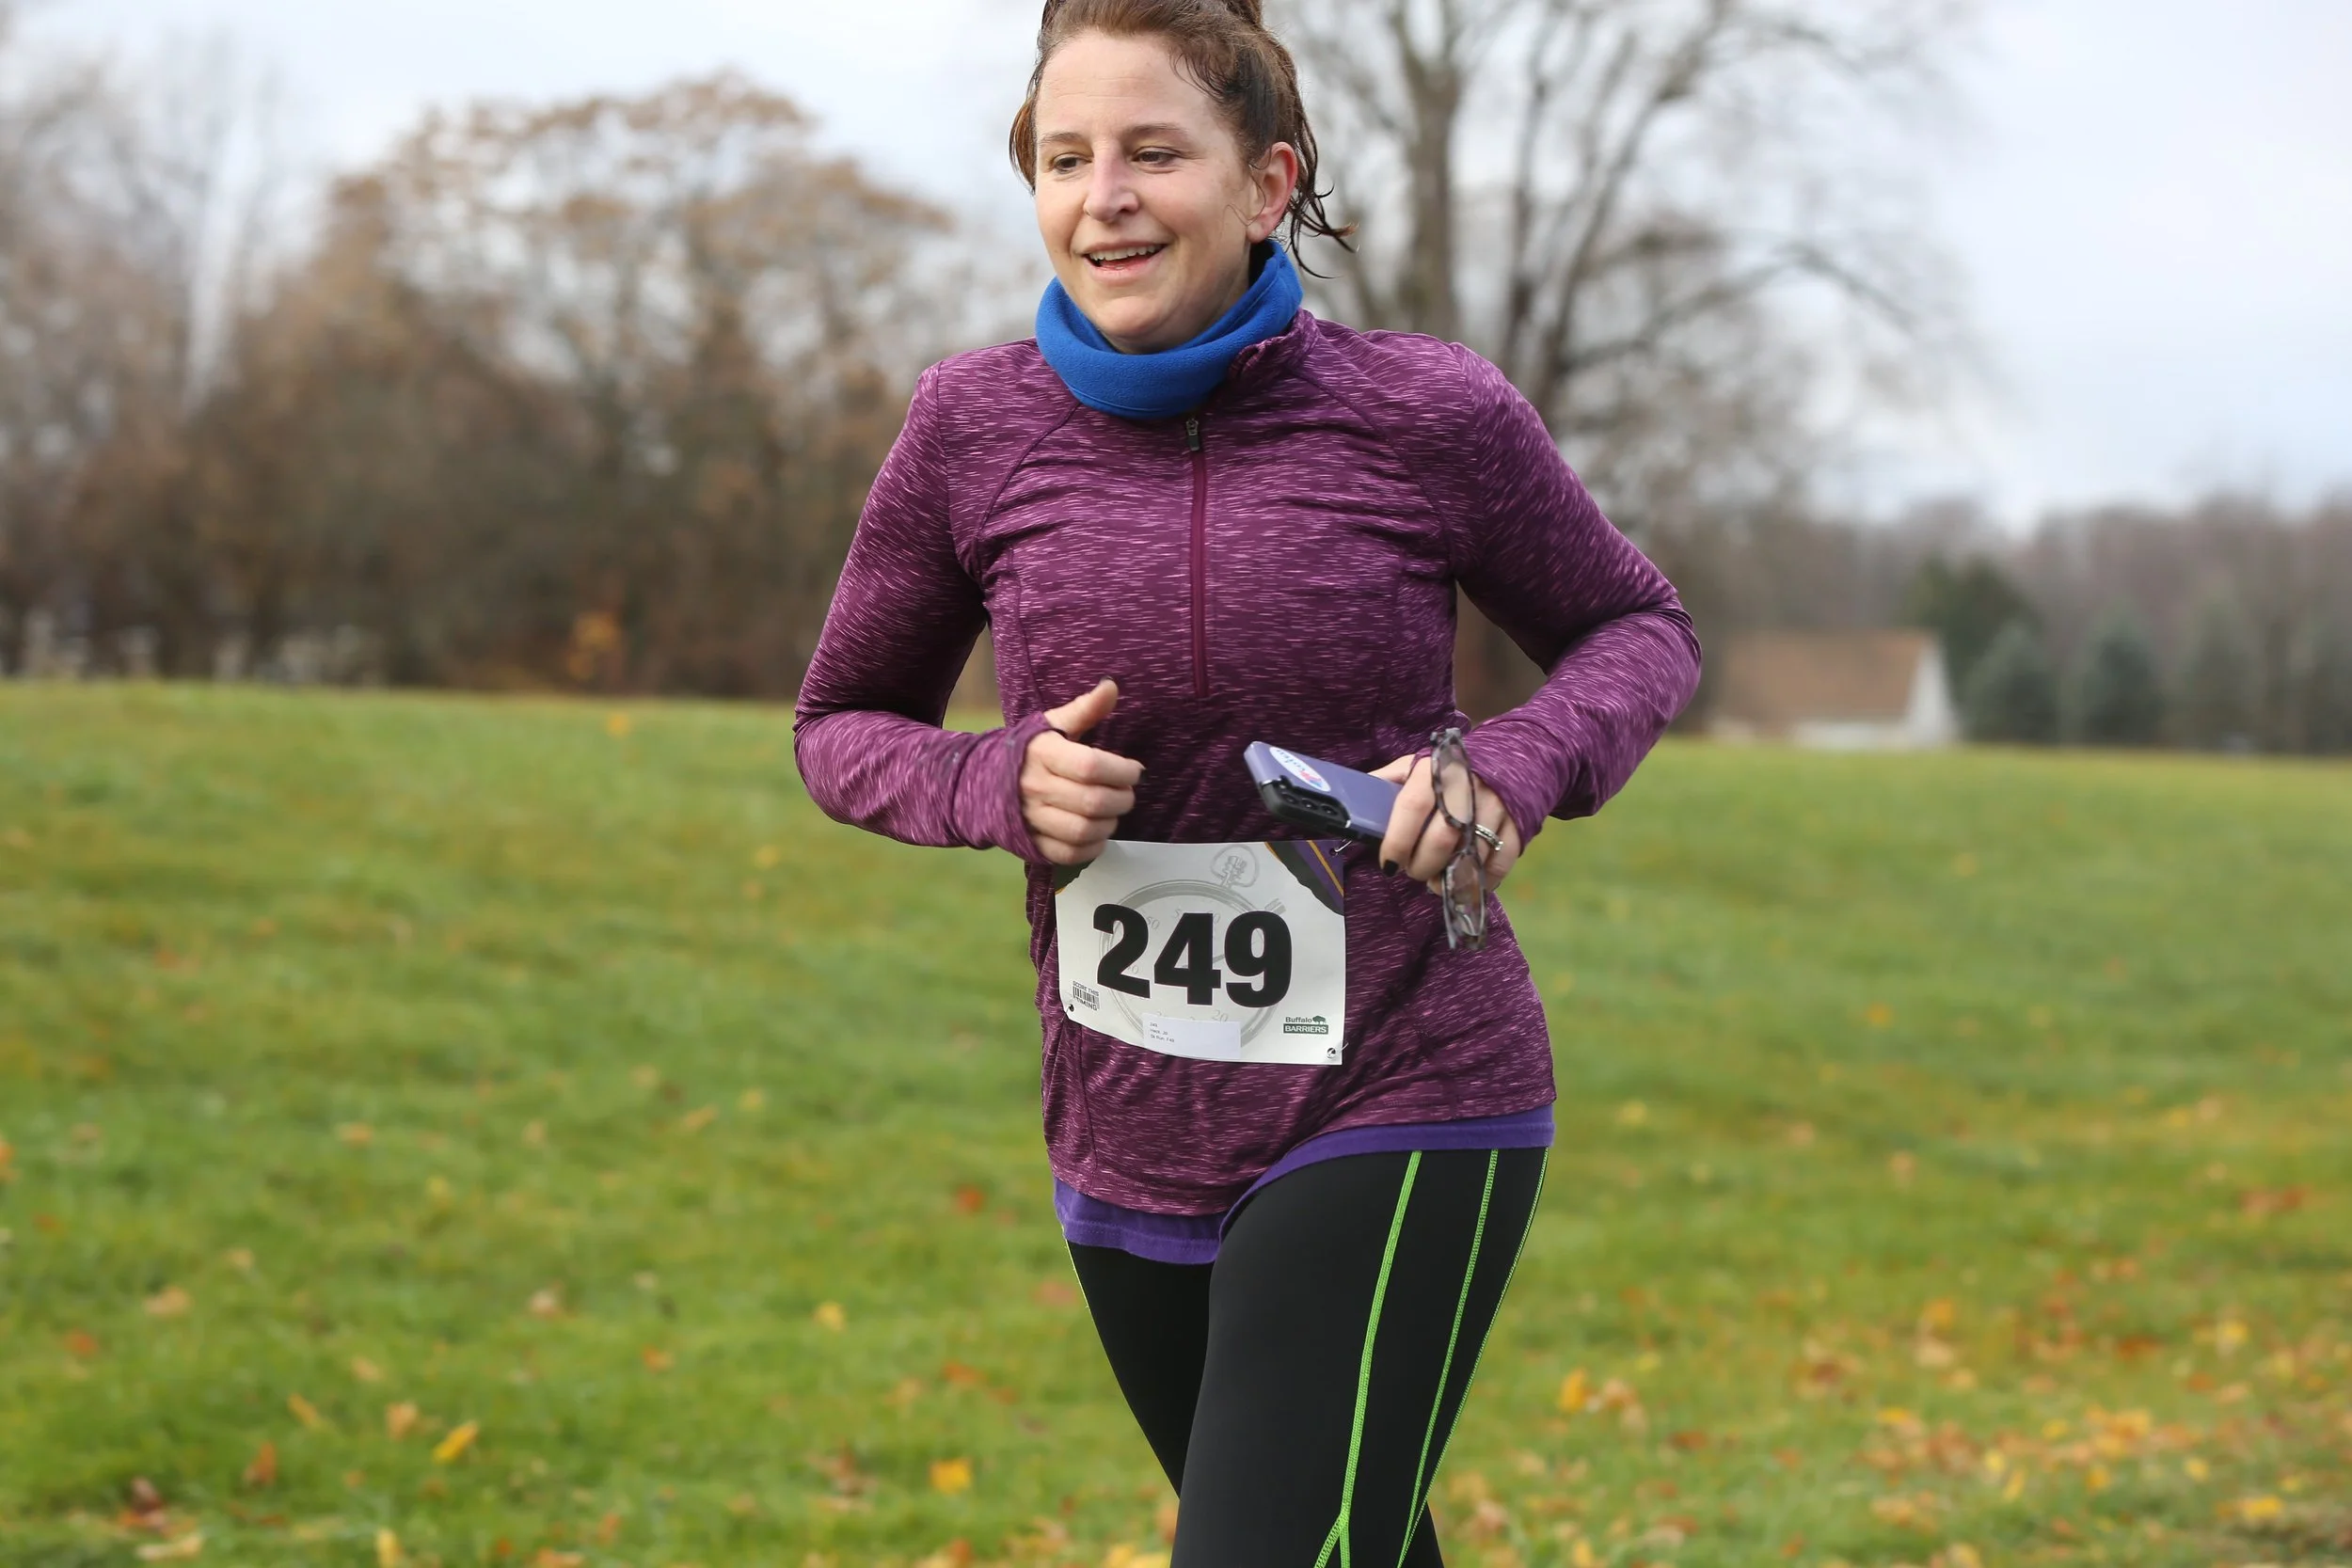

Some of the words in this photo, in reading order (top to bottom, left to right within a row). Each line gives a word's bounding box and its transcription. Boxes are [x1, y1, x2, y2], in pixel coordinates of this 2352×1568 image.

[1093, 904, 1293, 1008] 249
[1076, 997, 1098, 1011] TIMING
[1284, 1025, 1327, 1034] BARRIERS
